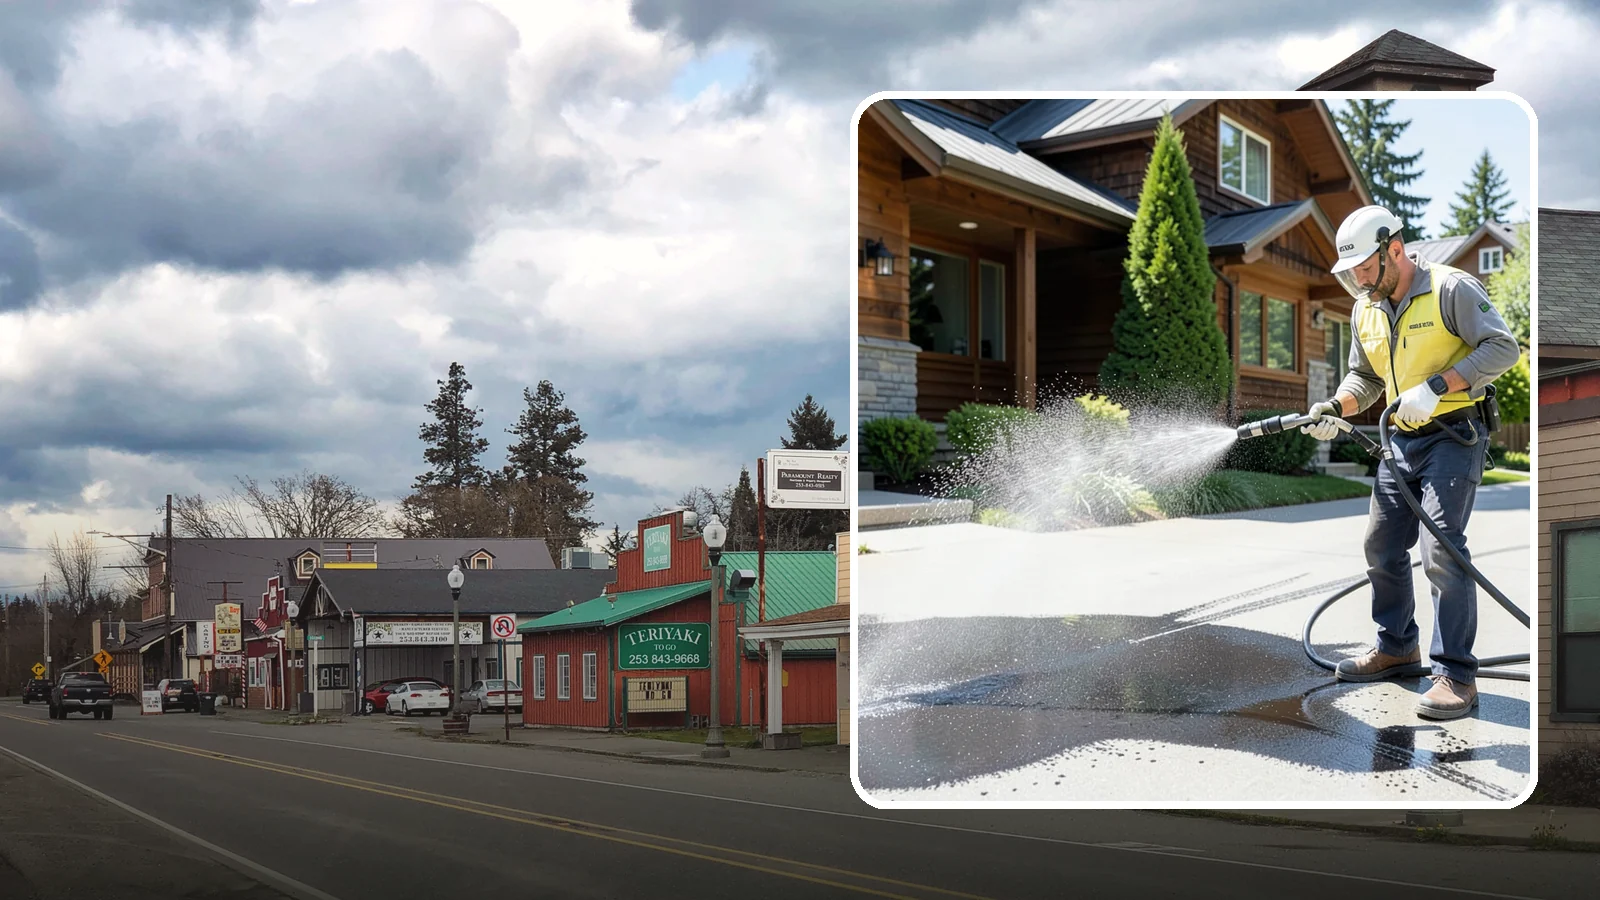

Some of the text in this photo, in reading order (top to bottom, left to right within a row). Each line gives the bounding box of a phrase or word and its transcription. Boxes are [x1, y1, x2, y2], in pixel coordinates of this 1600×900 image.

[625, 627, 702, 645] TERIYAKI
[629, 653, 700, 664] 253 843-9668
